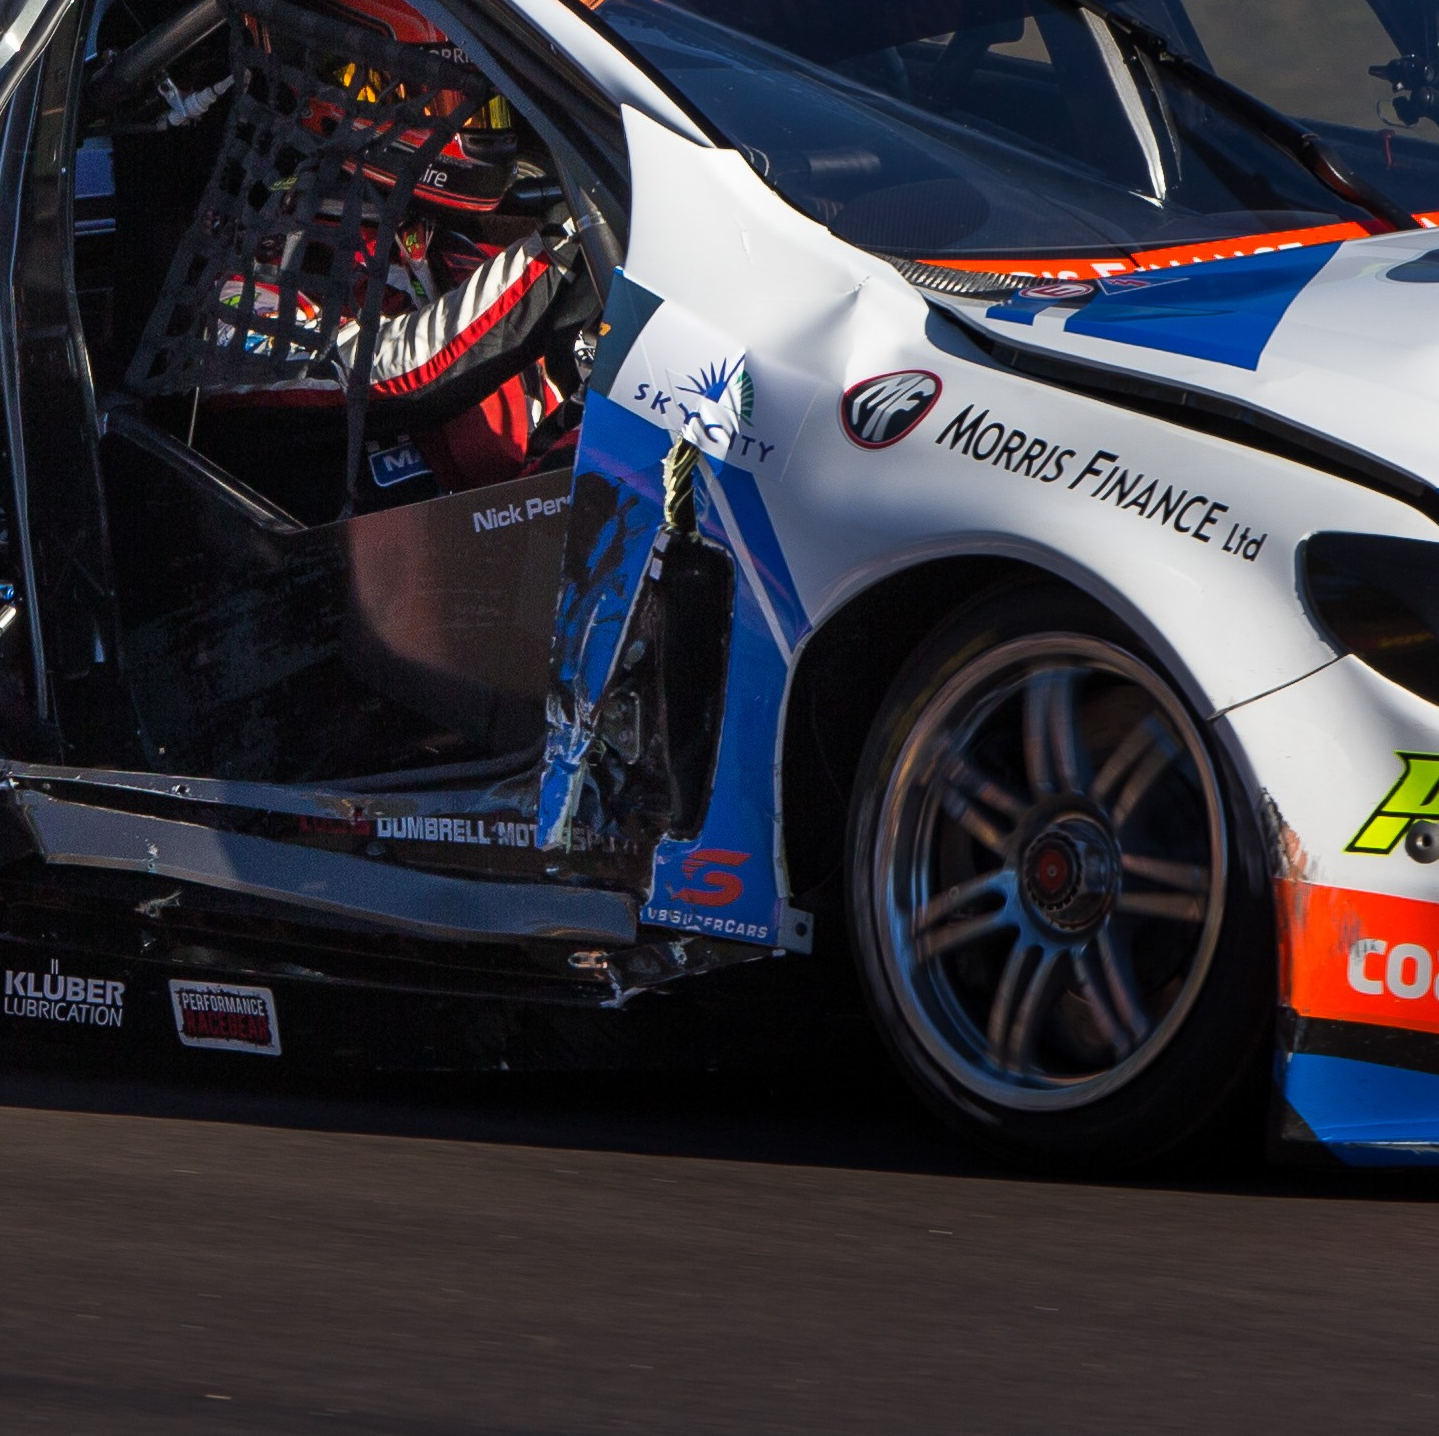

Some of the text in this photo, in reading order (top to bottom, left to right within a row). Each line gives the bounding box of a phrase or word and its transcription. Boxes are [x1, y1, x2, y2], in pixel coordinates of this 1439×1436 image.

[936, 404, 1267, 562] MORRIS FINANCE Ltd
[472, 504, 524, 533] Nick
[377, 817, 491, 845] DUMBRELL
[4, 996, 123, 1028] LUBRICATION
[182, 992, 265, 1017] PERFORMANCE
